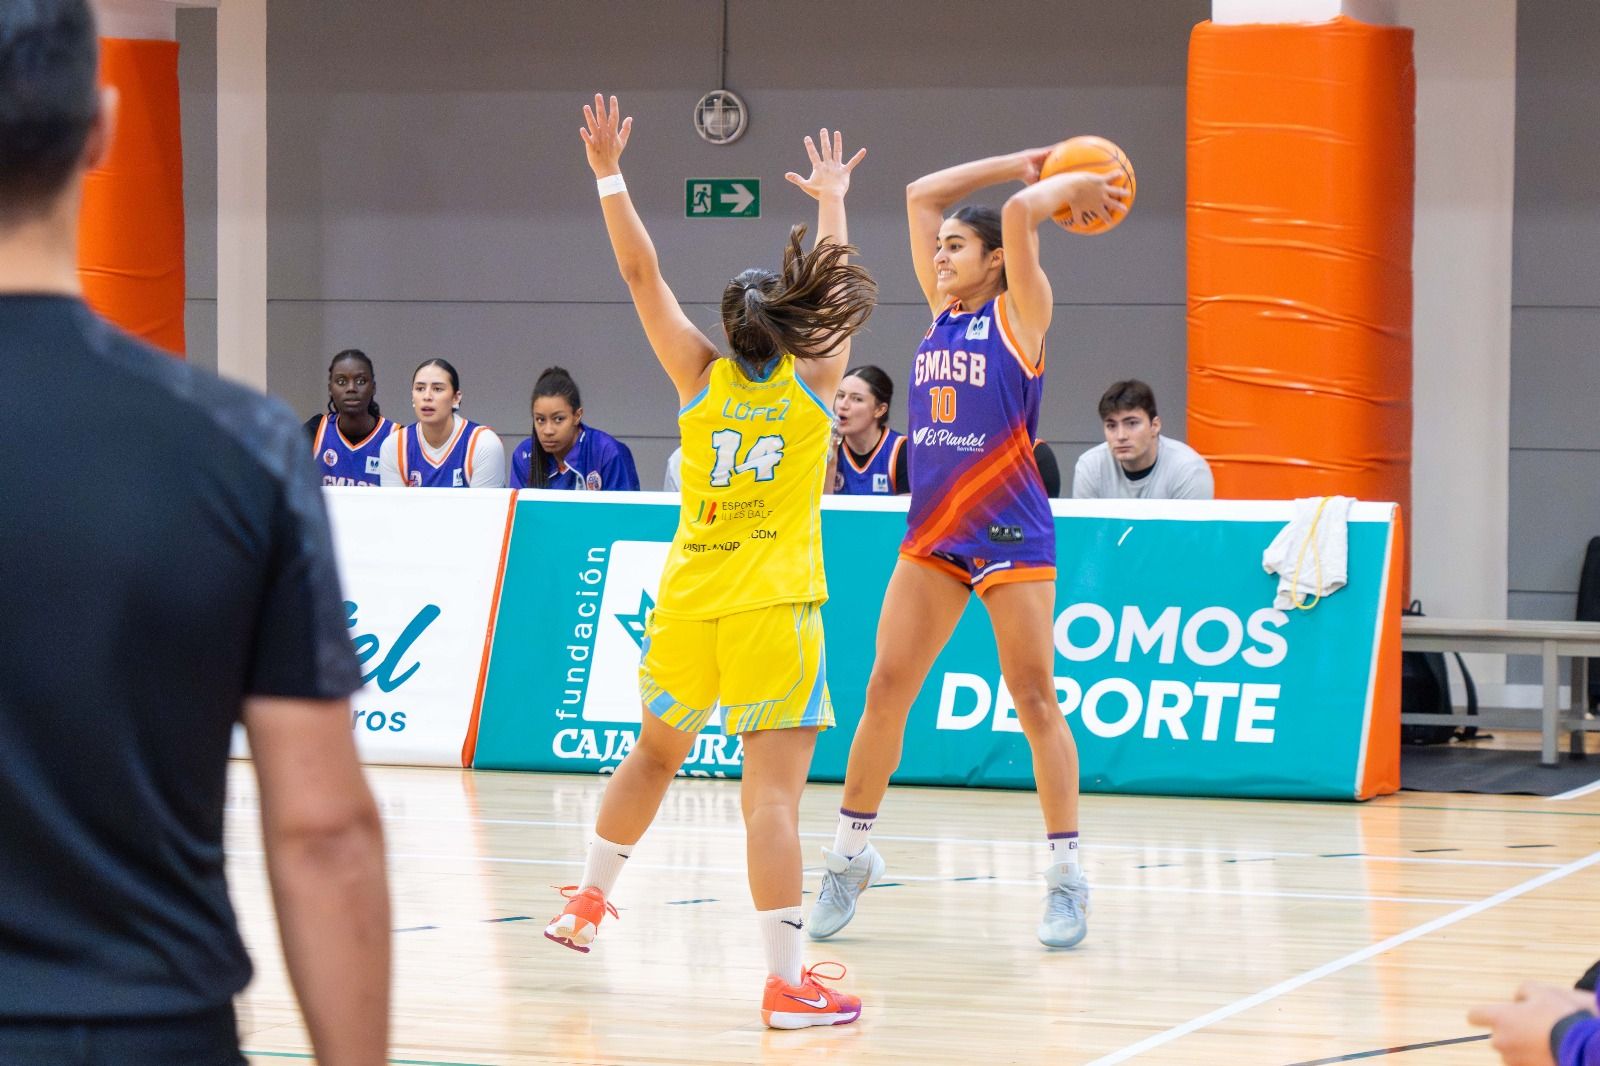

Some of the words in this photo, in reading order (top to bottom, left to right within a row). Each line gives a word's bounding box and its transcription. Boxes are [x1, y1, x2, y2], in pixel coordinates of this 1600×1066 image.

[914, 349, 987, 388] GMASB
[929, 386, 957, 424] 10
[710, 428, 785, 487] 14
[937, 429, 986, 447] Plantel
[722, 500, 765, 511] ESPORTS
[344, 600, 441, 693] el
[555, 546, 606, 721] fundación
[1053, 602, 1290, 668] OMOS
[352, 710, 407, 732] ros
[936, 671, 1281, 743] DEPORTE
[552, 728, 637, 762] CAJA
